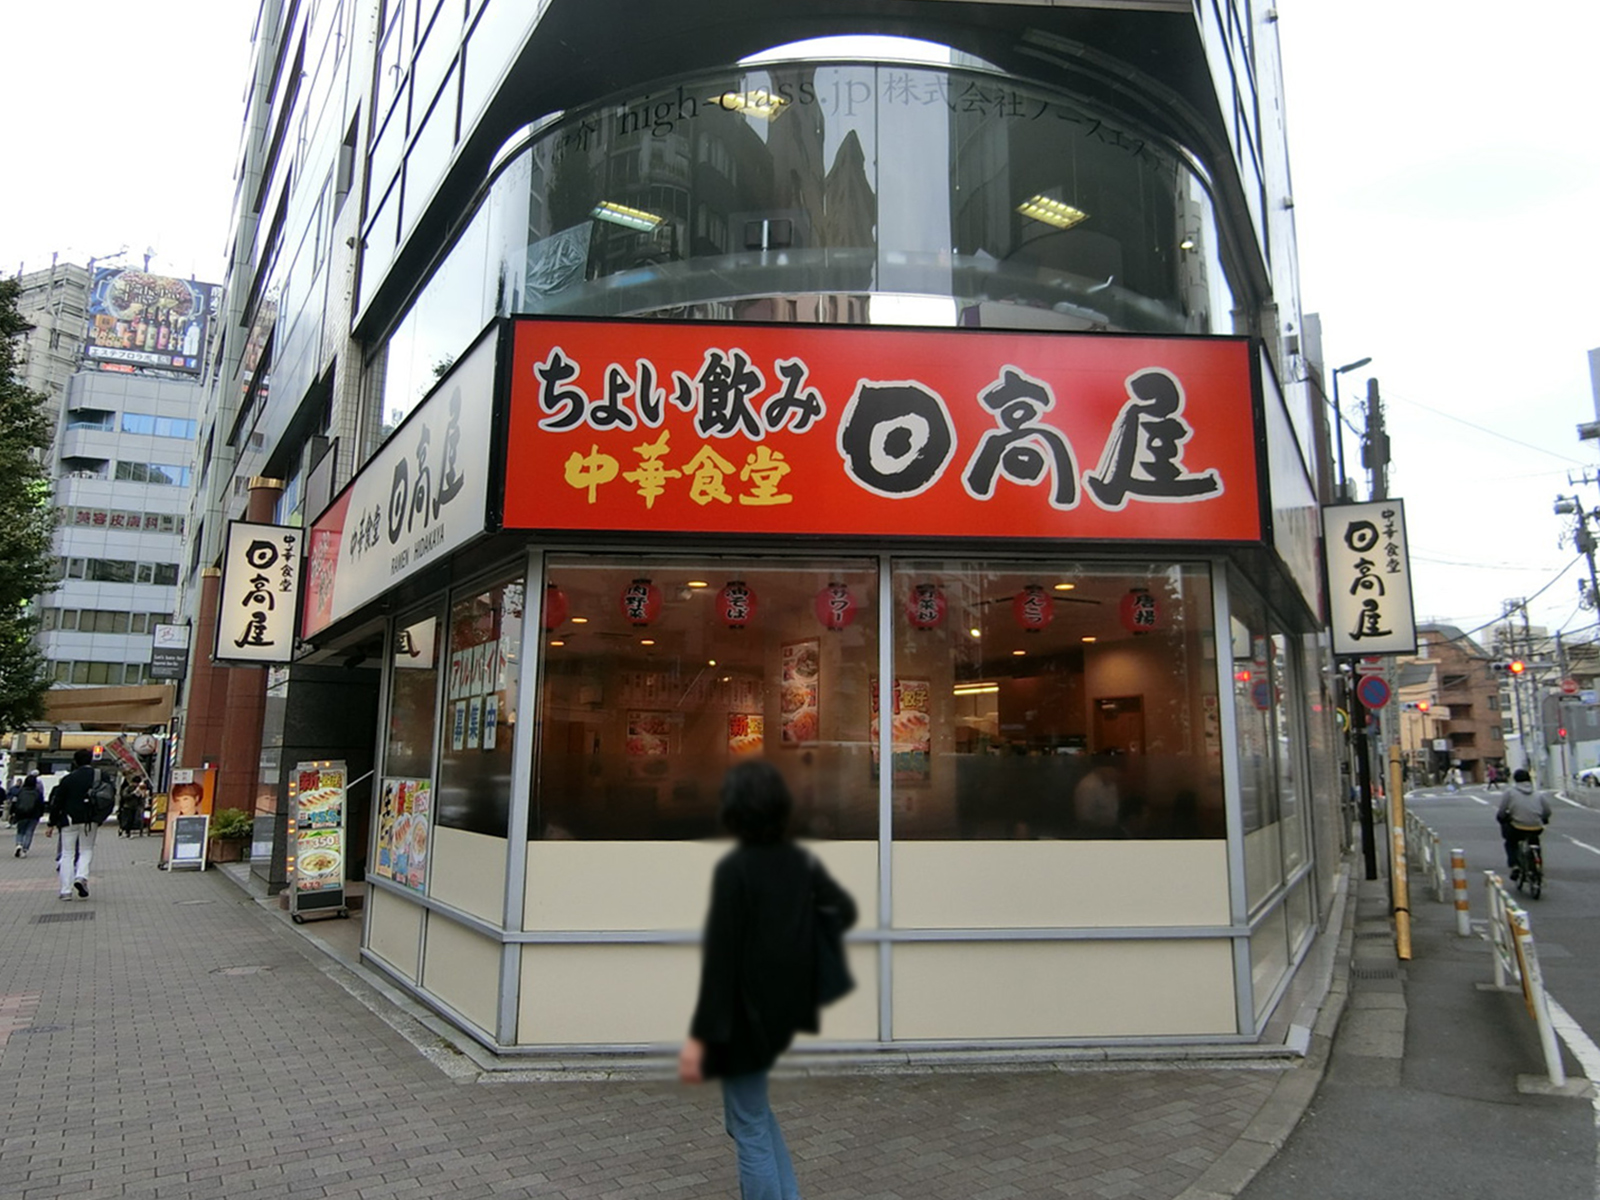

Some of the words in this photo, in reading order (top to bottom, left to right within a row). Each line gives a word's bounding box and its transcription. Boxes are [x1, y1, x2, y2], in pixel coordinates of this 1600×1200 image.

[619, 70, 871, 138] high-class.jp
[884, 73, 1164, 172] 株式会社ノースエス
[534, 346, 824, 438] ちょい飲み
[837, 364, 1225, 511] 日高屋
[388, 385, 464, 544] 日高屋
[564, 431, 794, 508] 中華食堂
[279, 534, 296, 592] 中華食堂
[1344, 520, 1393, 641] 日高屋
[1381, 509, 1401, 573] 中華食堂
[234, 540, 279, 648] 日高屋
[830, 588, 850, 622] サワー
[452, 648, 508, 691] アルバイト
